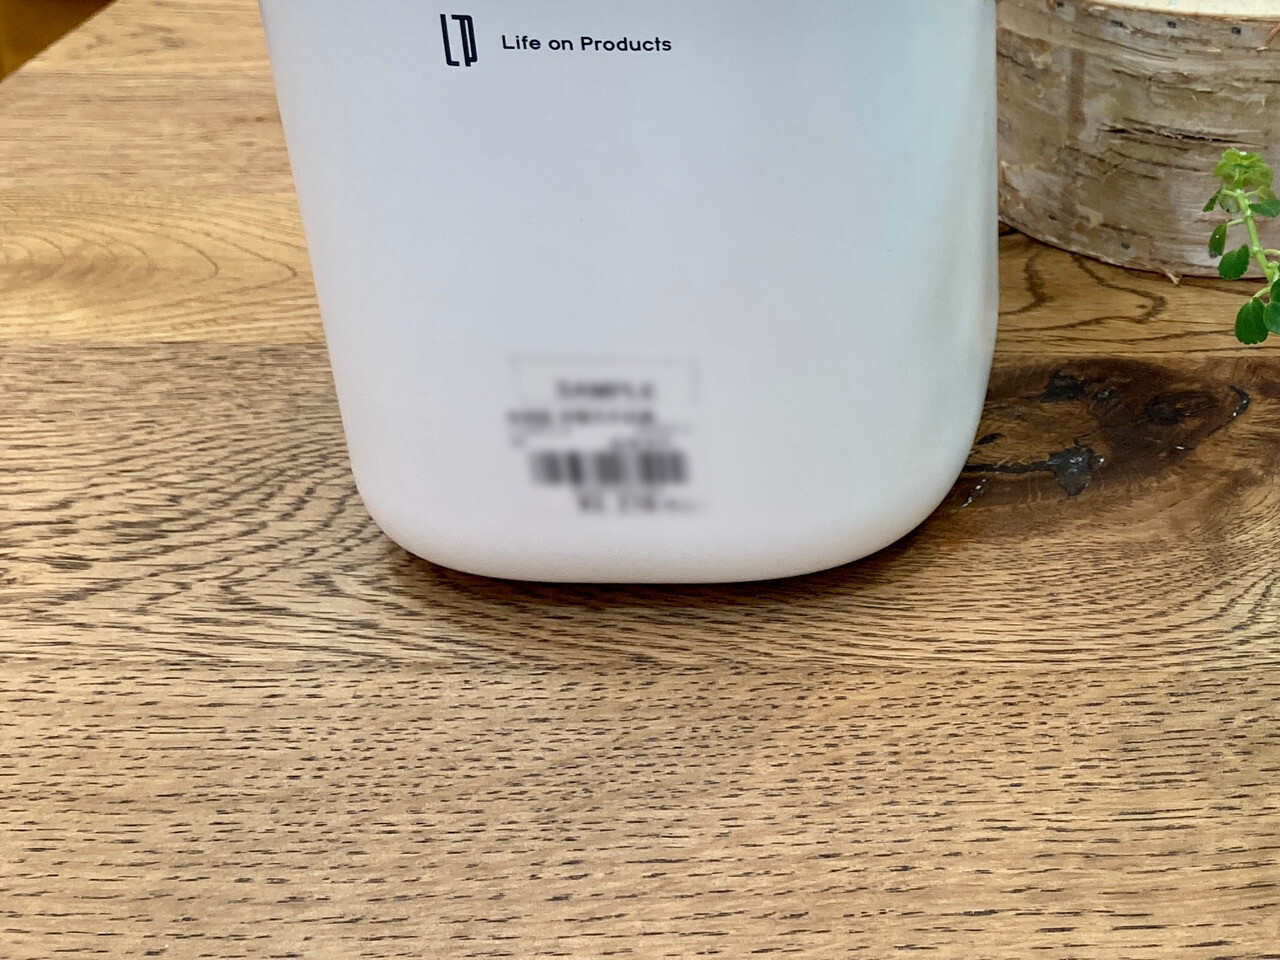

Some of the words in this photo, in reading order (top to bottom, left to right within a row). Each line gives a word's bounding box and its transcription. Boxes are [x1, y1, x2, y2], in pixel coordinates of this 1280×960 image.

[501, 35, 541, 50] Life
[548, 39, 574, 51] on
[580, 37, 672, 52] Products
